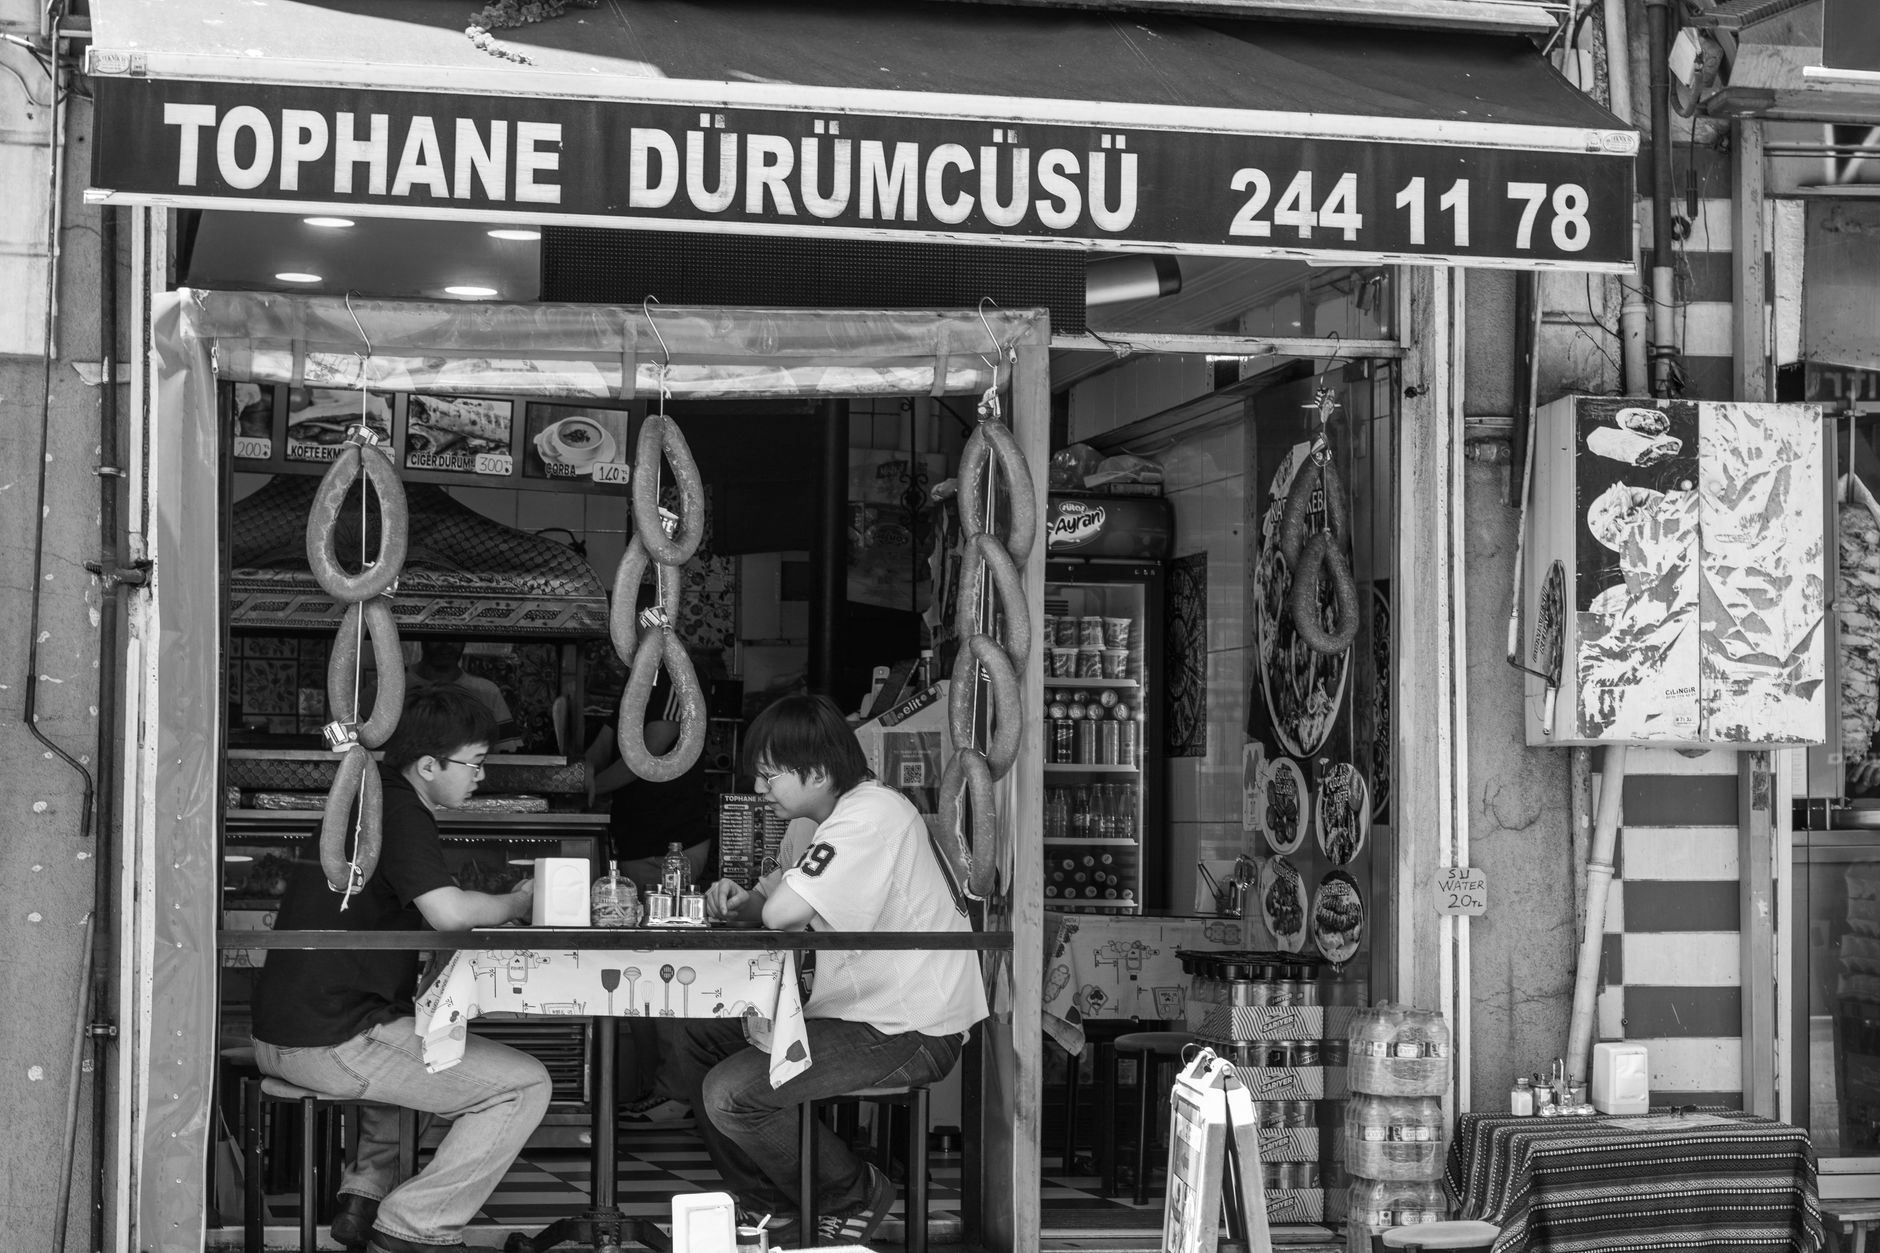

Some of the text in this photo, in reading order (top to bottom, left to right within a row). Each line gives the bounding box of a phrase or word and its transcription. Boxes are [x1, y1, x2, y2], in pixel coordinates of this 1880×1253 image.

[164, 103, 1590, 251] TOPHANE DÜRÜMCÜSÜ 244 11 78
[238, 442, 262, 457] 200
[291, 442, 345, 461] KÖFTE EKM
[479, 456, 504, 473] 300
[599, 466, 620, 482] 140
[1055, 509, 1102, 536] Ayran
[1447, 868, 1470, 880] SU
[1437, 879, 1486, 892] WATER
[1262, 1015, 1294, 1033] SARIYER
[1261, 1075, 1294, 1093] SARIYER
[1260, 1136, 1289, 1153] ARIYER
[1266, 1197, 1295, 1214] ARIYER
